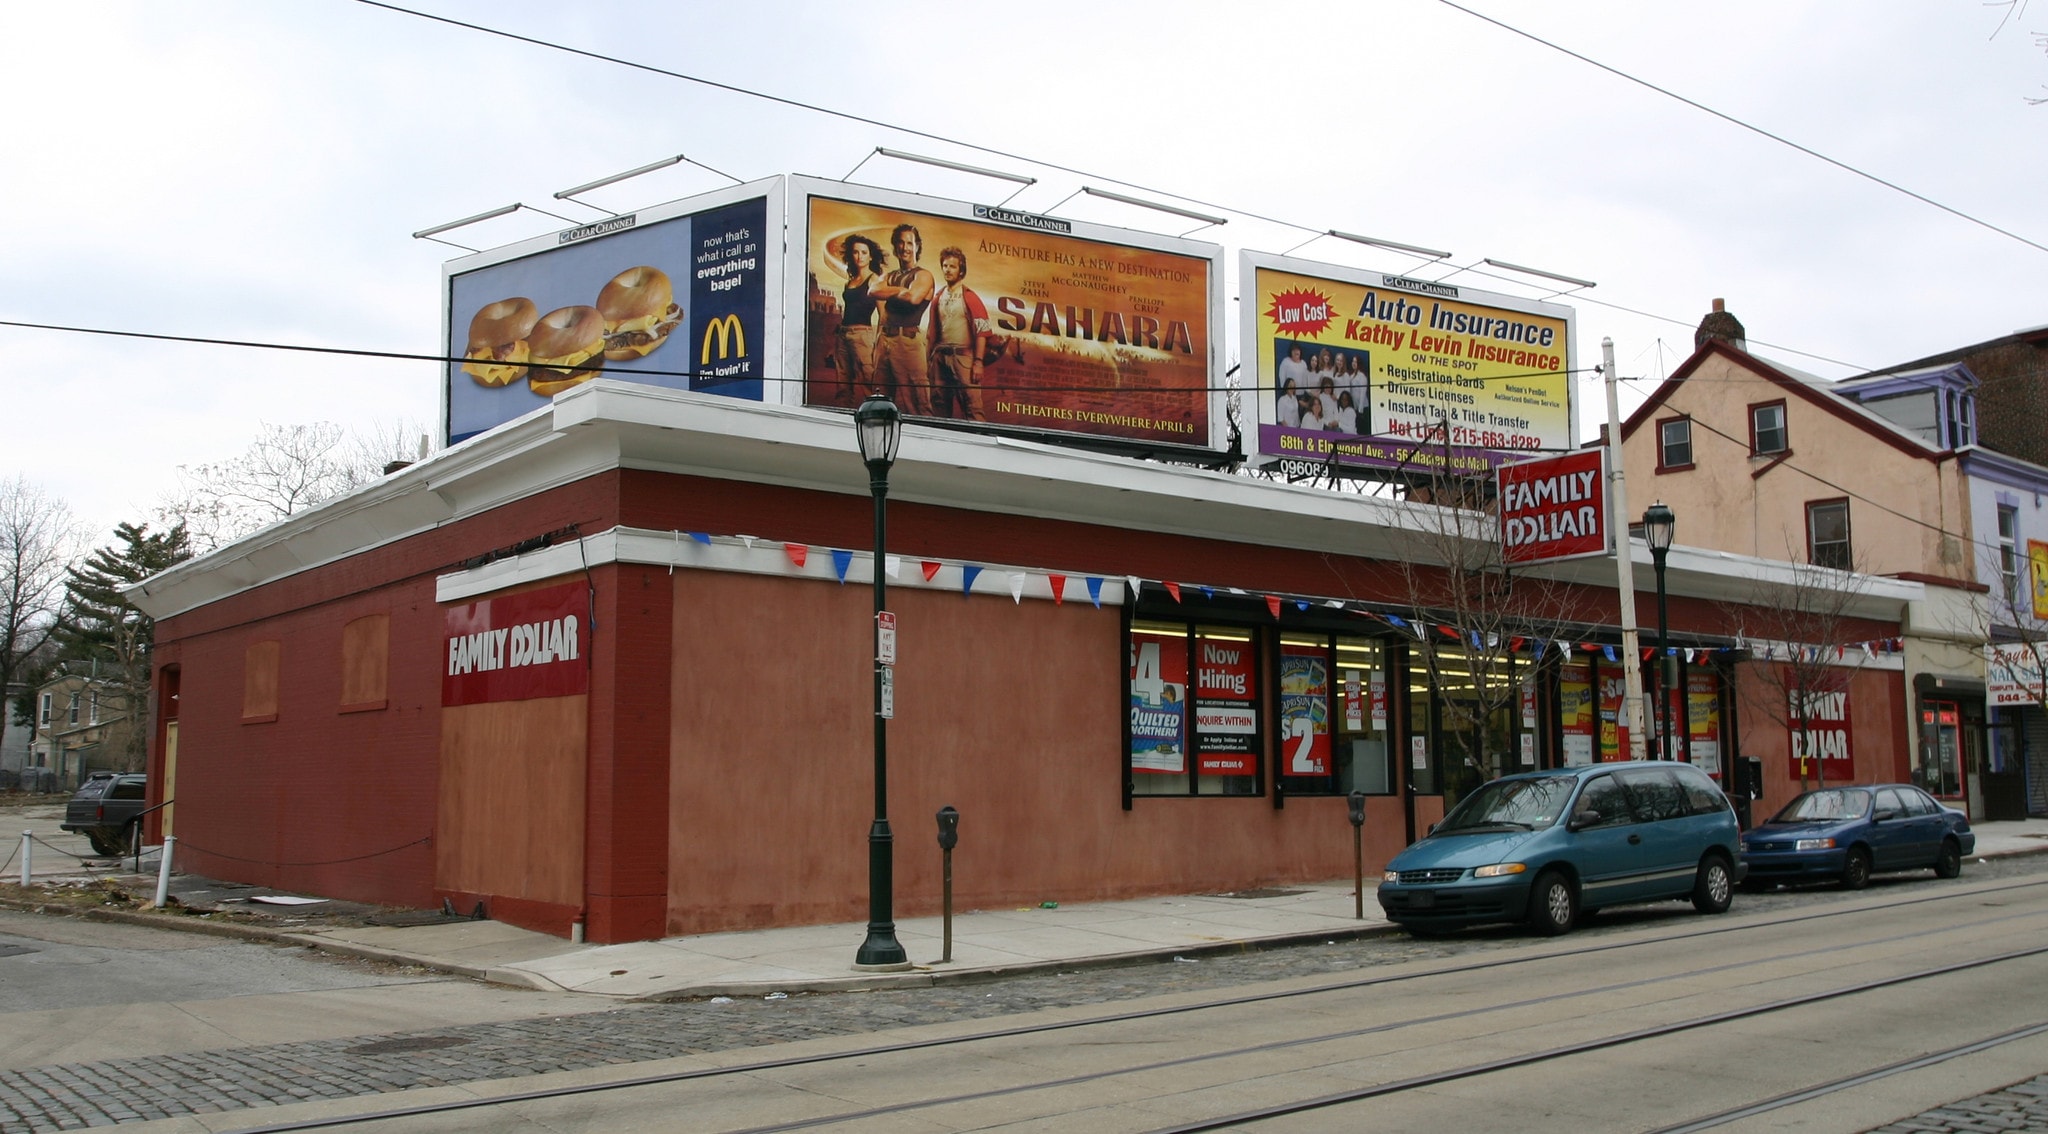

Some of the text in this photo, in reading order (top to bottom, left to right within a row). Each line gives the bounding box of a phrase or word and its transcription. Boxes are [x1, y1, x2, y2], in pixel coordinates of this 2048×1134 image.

[704, 228, 750, 248] now that's
[697, 243, 756, 264] what i call an
[979, 238, 1192, 285] ADVENTURE HAS A NEW DESTINATION.
[697, 257, 756, 279] everything
[1072, 271, 1110, 283] MATTHEW
[711, 275, 742, 292] bagel
[1020, 287, 1050, 299] ZAHN
[1023, 280, 1046, 290] STEVE
[1129, 295, 1165, 307] PENELOPE
[1133, 304, 1160, 315] CRUZ
[1278, 302, 1328, 324] Low Cost
[1358, 291, 1554, 346] Auto Insurance
[997, 296, 1193, 355] SAHARA
[1344, 319, 1560, 371] Kathy Levin Insurance
[715, 363, 741, 378] lovin'
[742, 360, 750, 373] it
[1411, 353, 1478, 371] ON THE SPOT
[1387, 365, 1485, 390] Registration Cards
[1388, 381, 1475, 405] Drivers Licenses
[996, 402, 1194, 434] IN THEATRES EVERYWHERE APRIL 8
[1388, 399, 1530, 430] Instant Tag & Title Transfer
[1388, 418, 1412, 438] Hot
[1280, 434, 1304, 451] 68th
[1306, 439, 1315, 452] &
[1396, 448, 1409, 462] 56
[1467, 456, 1488, 471] Mall
[1505, 470, 1596, 512] FAMILY
[1506, 506, 1597, 547] DOLLAR
[449, 614, 578, 676] FAMILY DOLLAR
[1204, 644, 1240, 665] Now
[1198, 668, 1246, 695] Hiring
[1990, 668, 2014, 682] NAI
[1197, 715, 1252, 727] NQUIRE WITHIN
